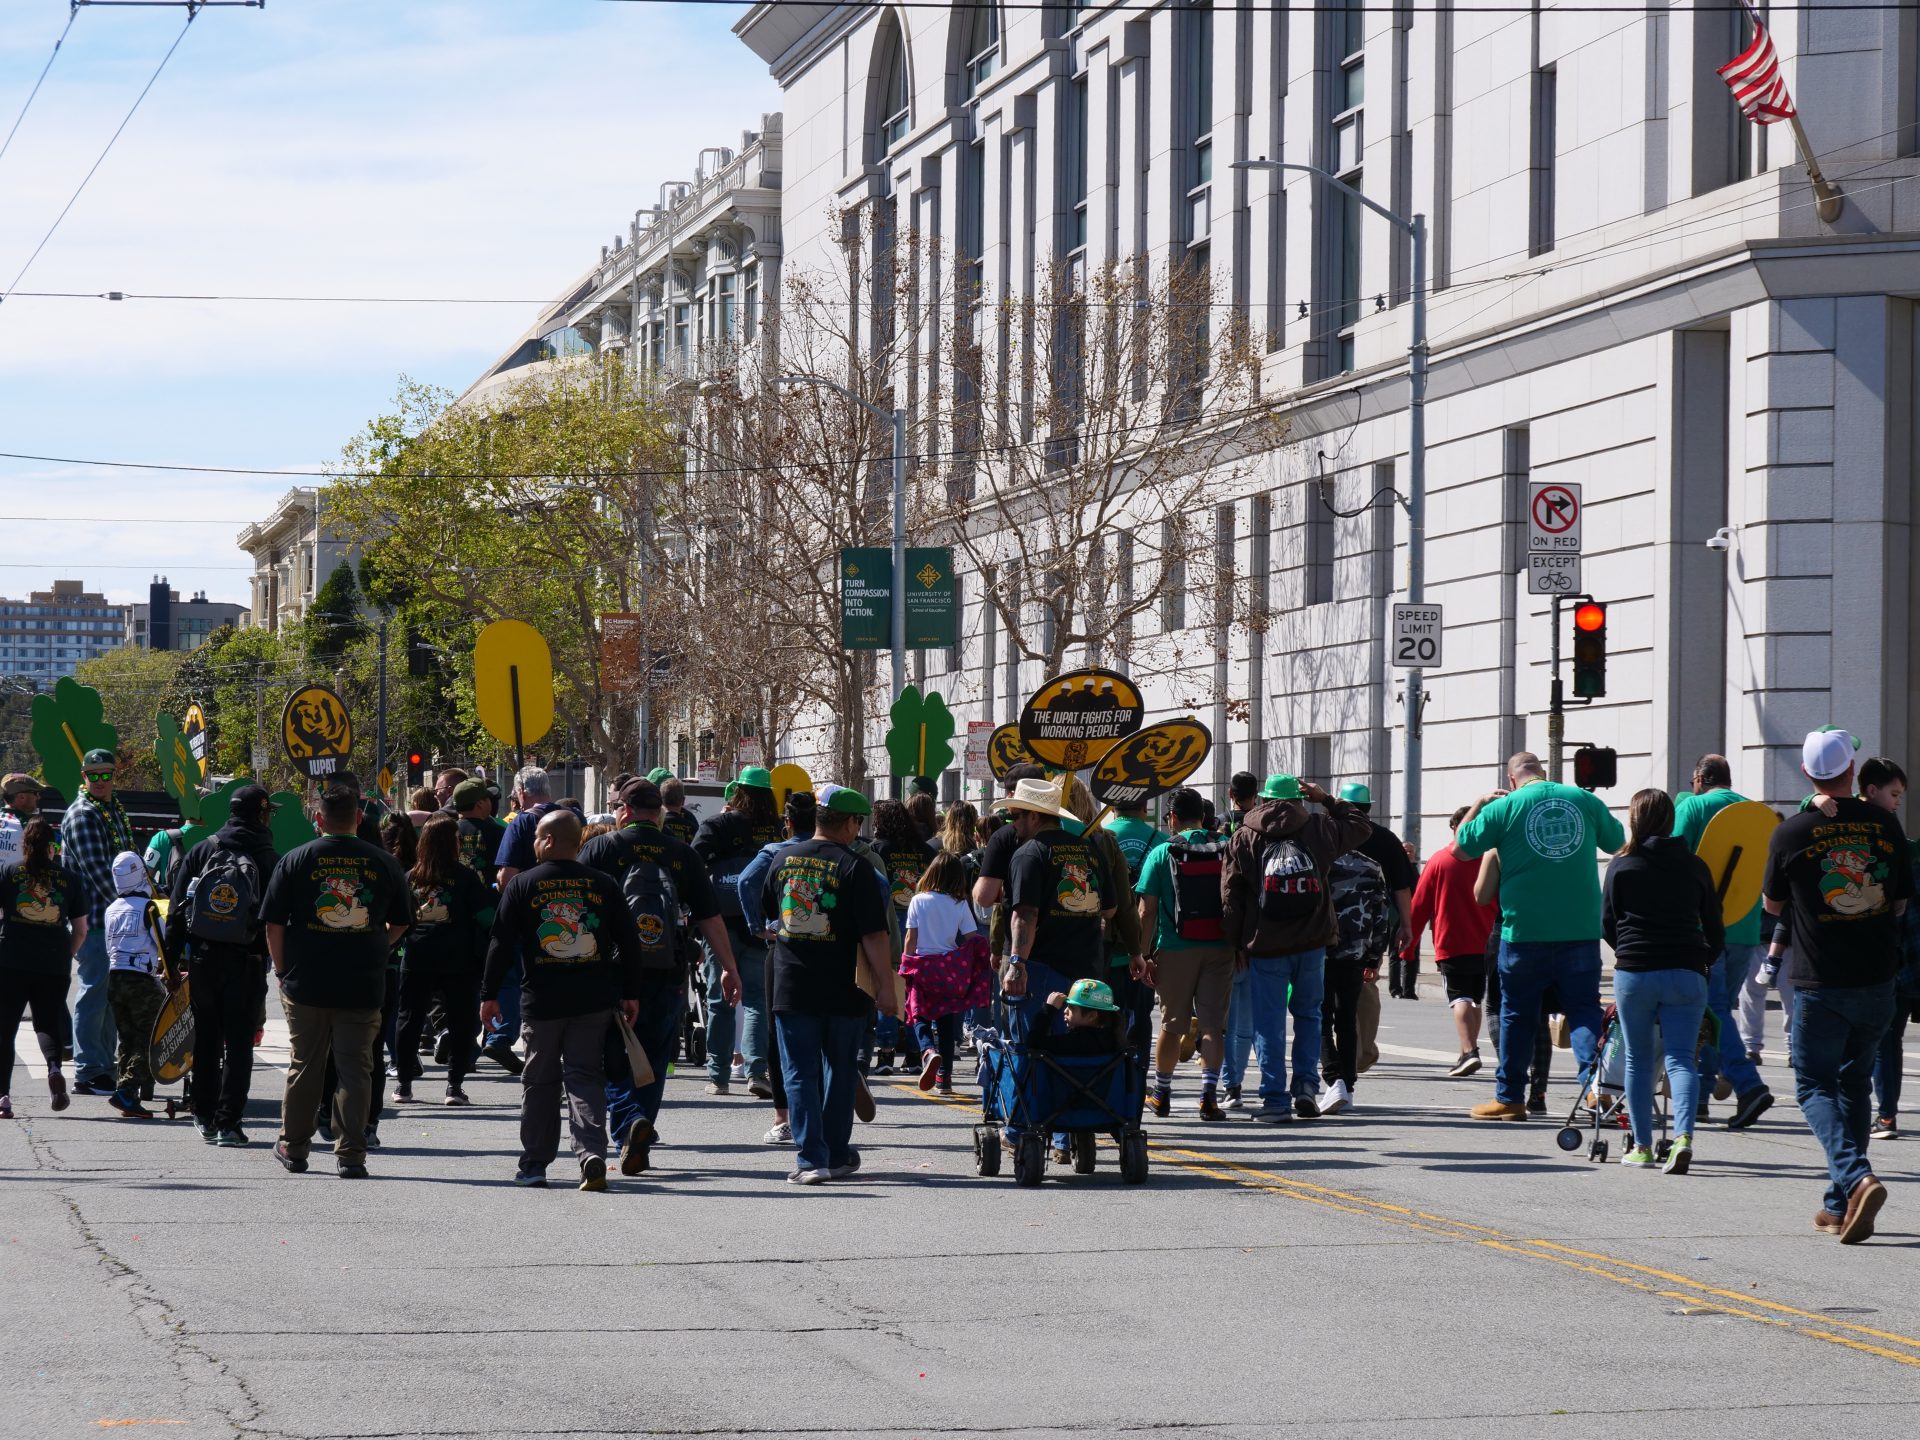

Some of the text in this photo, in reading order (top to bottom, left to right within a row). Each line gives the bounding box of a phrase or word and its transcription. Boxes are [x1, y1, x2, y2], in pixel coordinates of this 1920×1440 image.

[1532, 537, 1578, 546] ON RED
[1533, 558, 1576, 568] EXCEPT
[845, 580, 865, 588] TURN
[845, 589, 890, 598] COMPASSION
[845, 598, 862, 607] INTO
[846, 608, 874, 616] ACTION.
[1398, 611, 1438, 621] SPEED
[1402, 624, 1433, 634] LIMIT
[1398, 637, 1437, 660] 20
[1034, 710, 1132, 724] THE IUPAT FIGHTS FOR
[1040, 724, 1120, 738] WORKING PEOPLE
[309, 758, 336, 775] IUPAT
[1102, 784, 1148, 802] IUPAT
[1812, 823, 1883, 837] DISTRICT
[1807, 836, 1872, 858] COUNCIL
[785, 856, 836, 871] DISTRICT
[1052, 854, 1086, 865] COUNCIL
[311, 868, 378, 880] COUNCIL #16
[778, 868, 822, 880] COUNCIL
[538, 879, 592, 890] DISTRICT
[1264, 876, 1320, 894] REJECTS
[531, 890, 584, 908] COUNCIL
[160, 1020, 182, 1049] PEOPLE
[170, 1024, 190, 1053] FIGHTS
[158, 1048, 170, 1067] FOR
